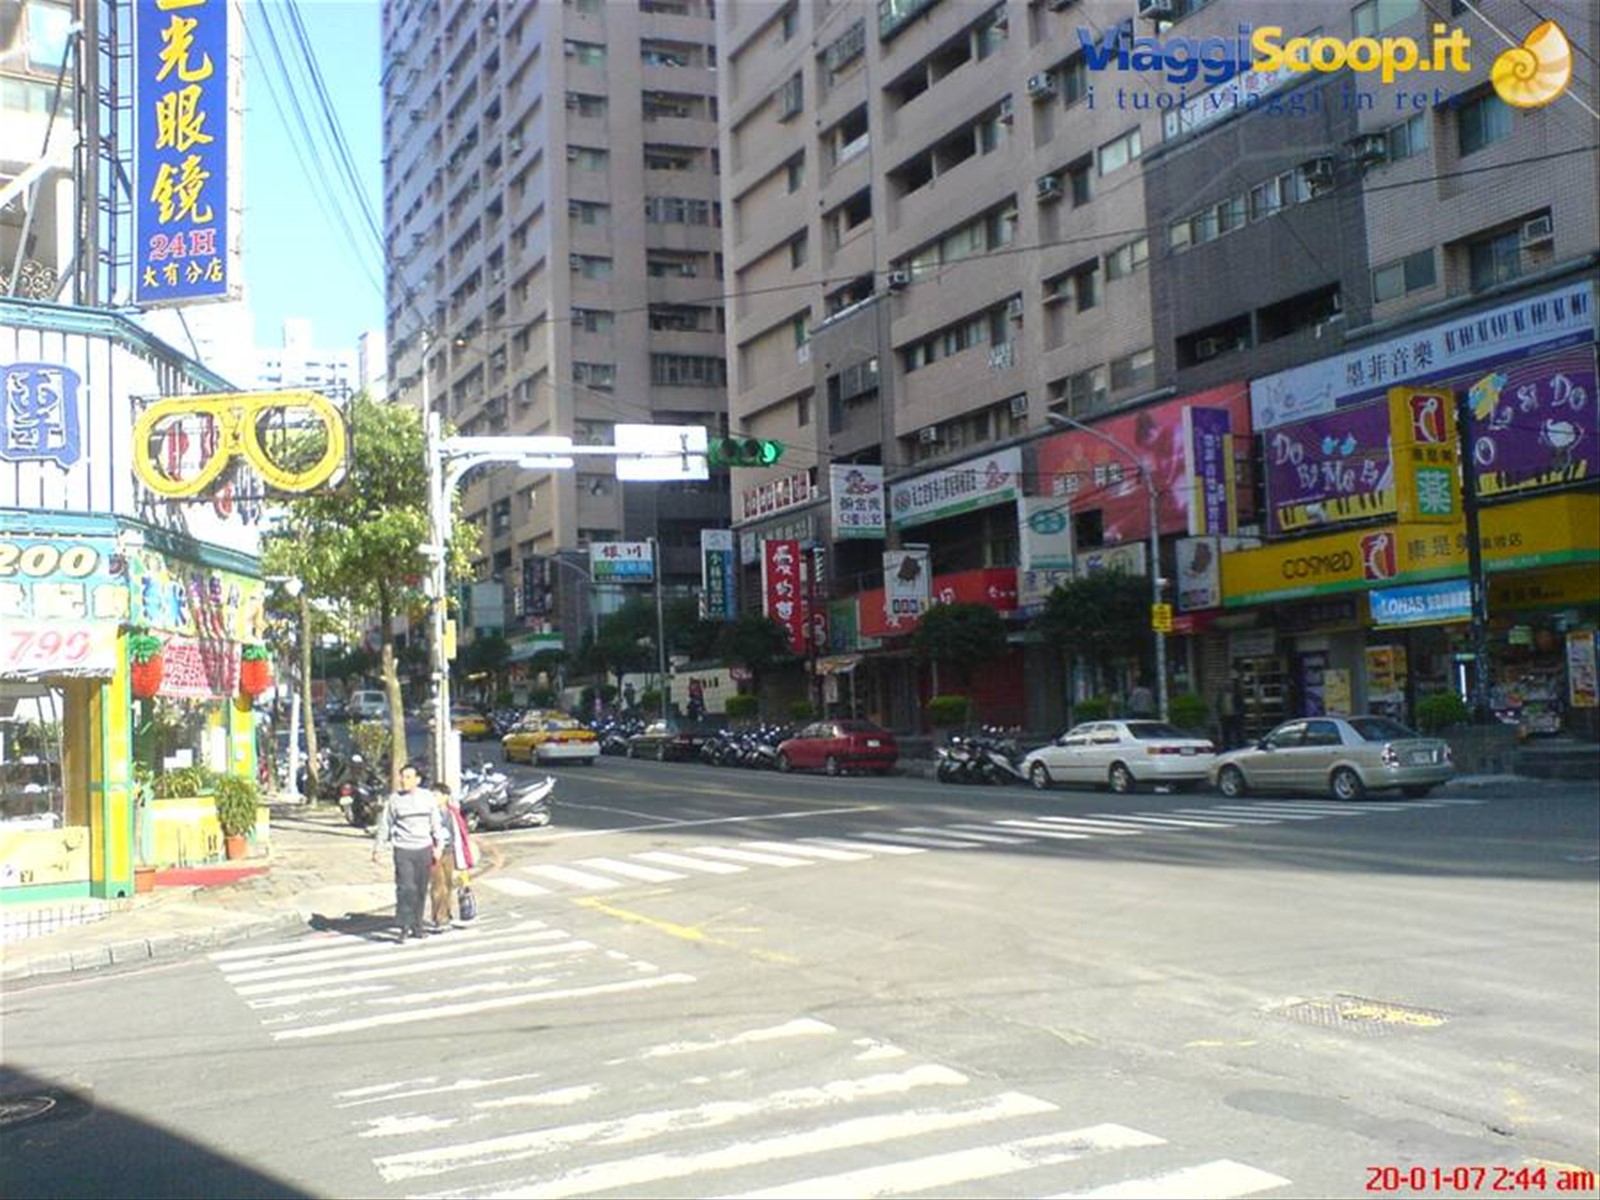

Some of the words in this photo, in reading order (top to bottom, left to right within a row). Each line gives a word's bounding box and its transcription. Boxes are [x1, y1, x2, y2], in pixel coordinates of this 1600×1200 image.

[150, 0, 214, 224] 光眼鏡
[149, 228, 217, 262] 24H
[1346, 339, 1433, 387] 墨菲音樂
